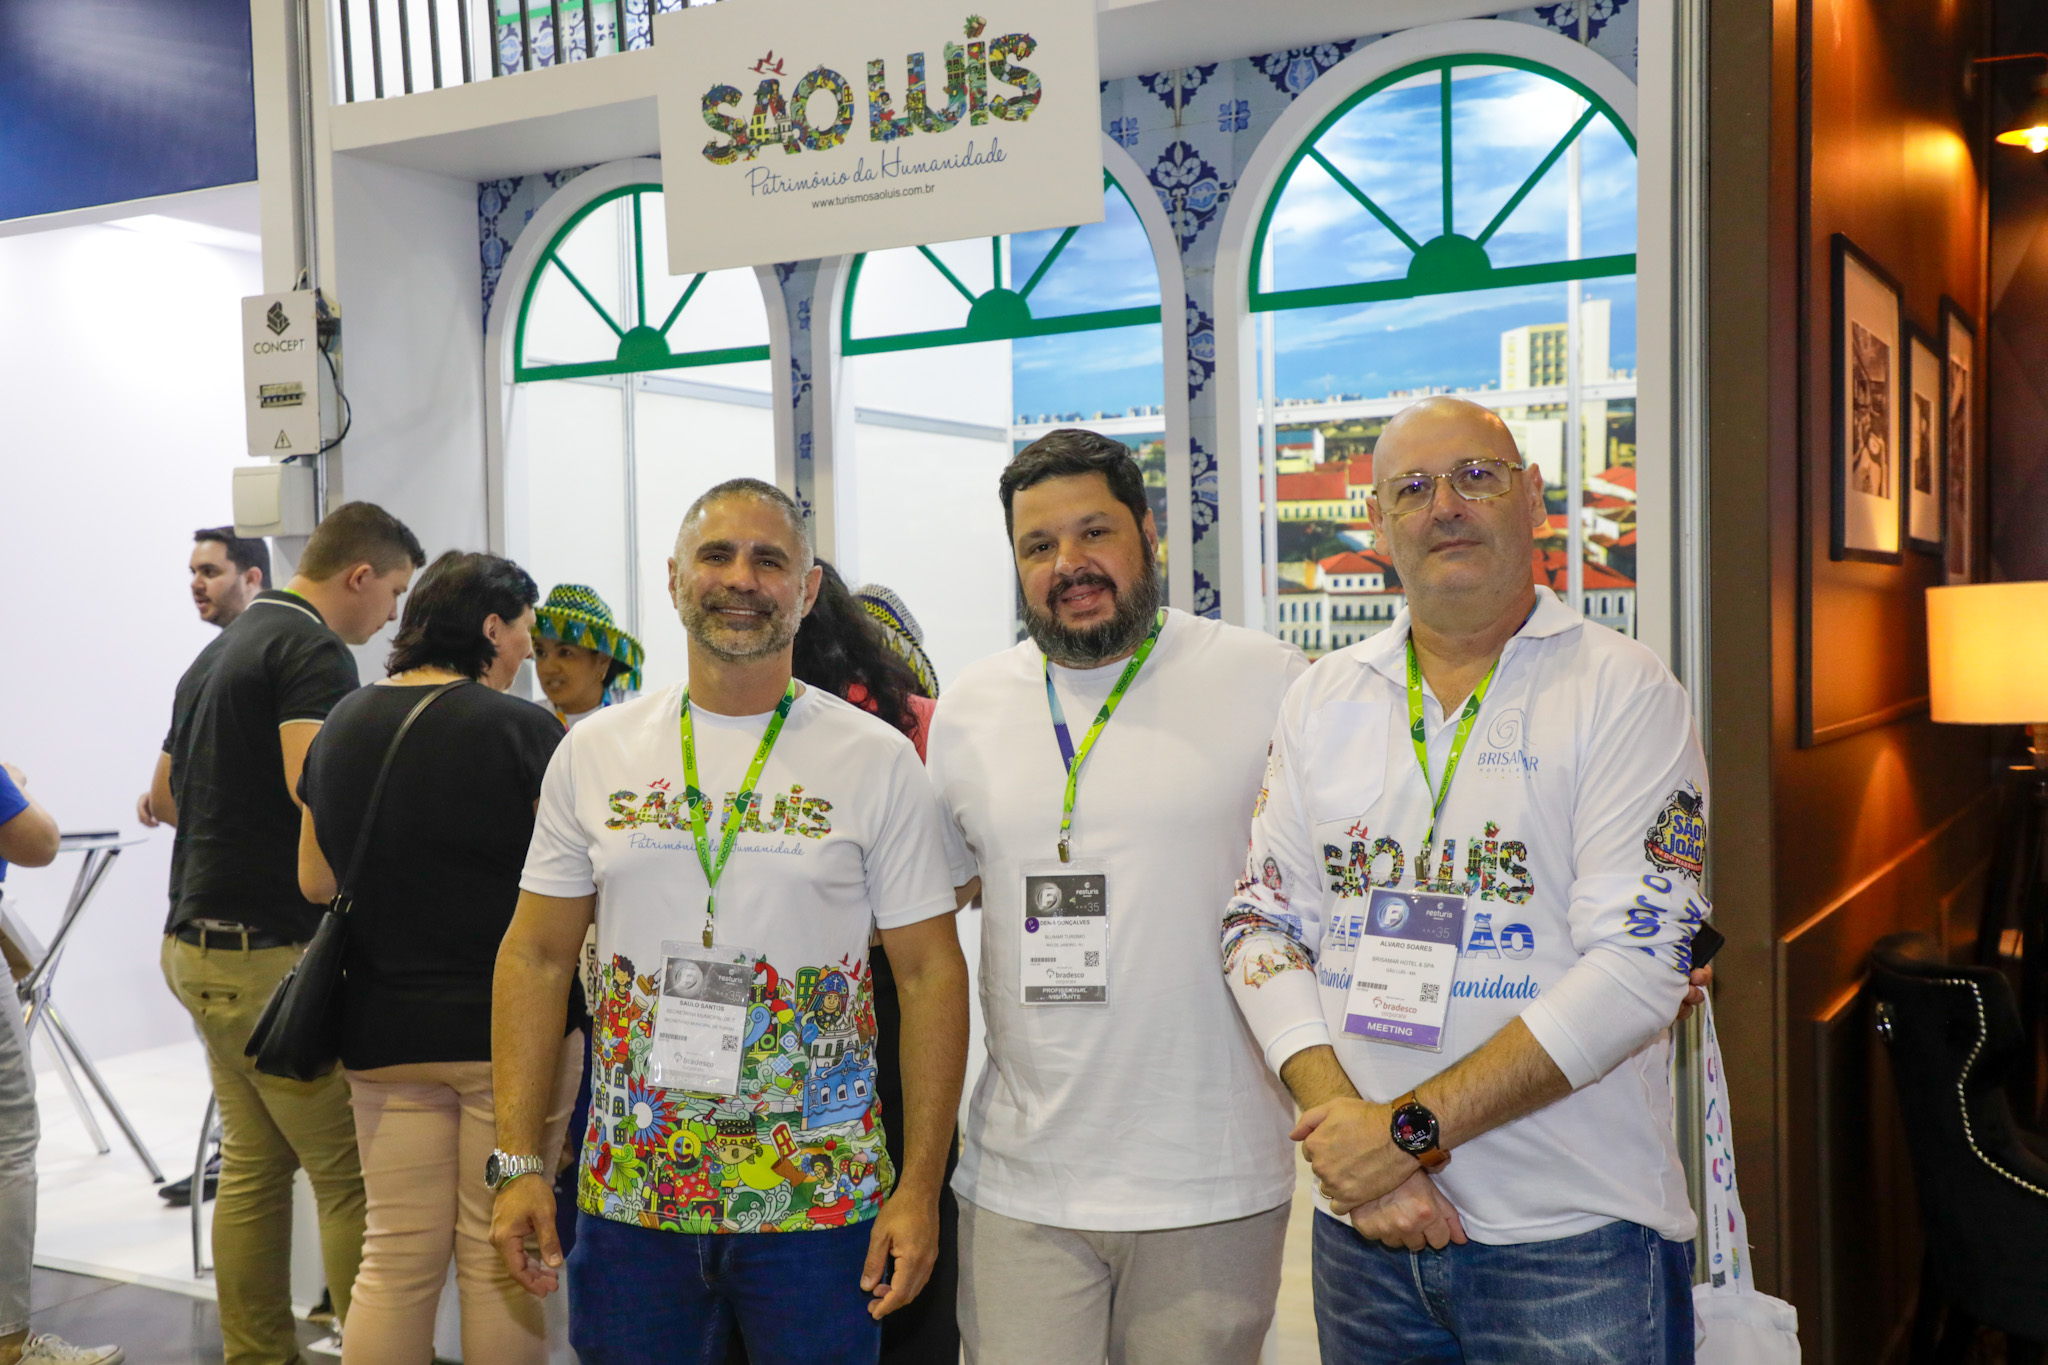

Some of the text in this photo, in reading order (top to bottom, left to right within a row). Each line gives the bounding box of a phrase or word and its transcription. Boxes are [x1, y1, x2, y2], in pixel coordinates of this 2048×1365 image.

[745, 136, 1007, 197] Patrimônio da Humanidade
[811, 183, 935, 209] www.turismosaoluis.com.br
[254, 339, 305, 354] CONCEPT
[758, 729, 775, 758] Localiza
[685, 740, 694, 770] Localiza
[1673, 814, 1702, 841] SÃO
[628, 833, 698, 852] Patrimôni
[718, 828, 734, 863] Localiza
[1663, 834, 1702, 862] JOÃO
[1087, 902, 1100, 912] 35
[1435, 926, 1450, 939] 35
[1380, 940, 1433, 952] ALVARO SOARES
[1372, 956, 1399, 965] BRISAMAR
[1400, 959, 1417, 967] HOTEL
[1453, 974, 1541, 999] anidade
[729, 990, 741, 1003] 35
[679, 1000, 725, 1012] SAULO SANTOS
[1382, 1002, 1417, 1014] bradesco
[1381, 1011, 1407, 1020] corporate
[1367, 1022, 1413, 1036] MEETING
[683, 1056, 714, 1069] bradesco
[1409, 1129, 1426, 1142] 13:10
